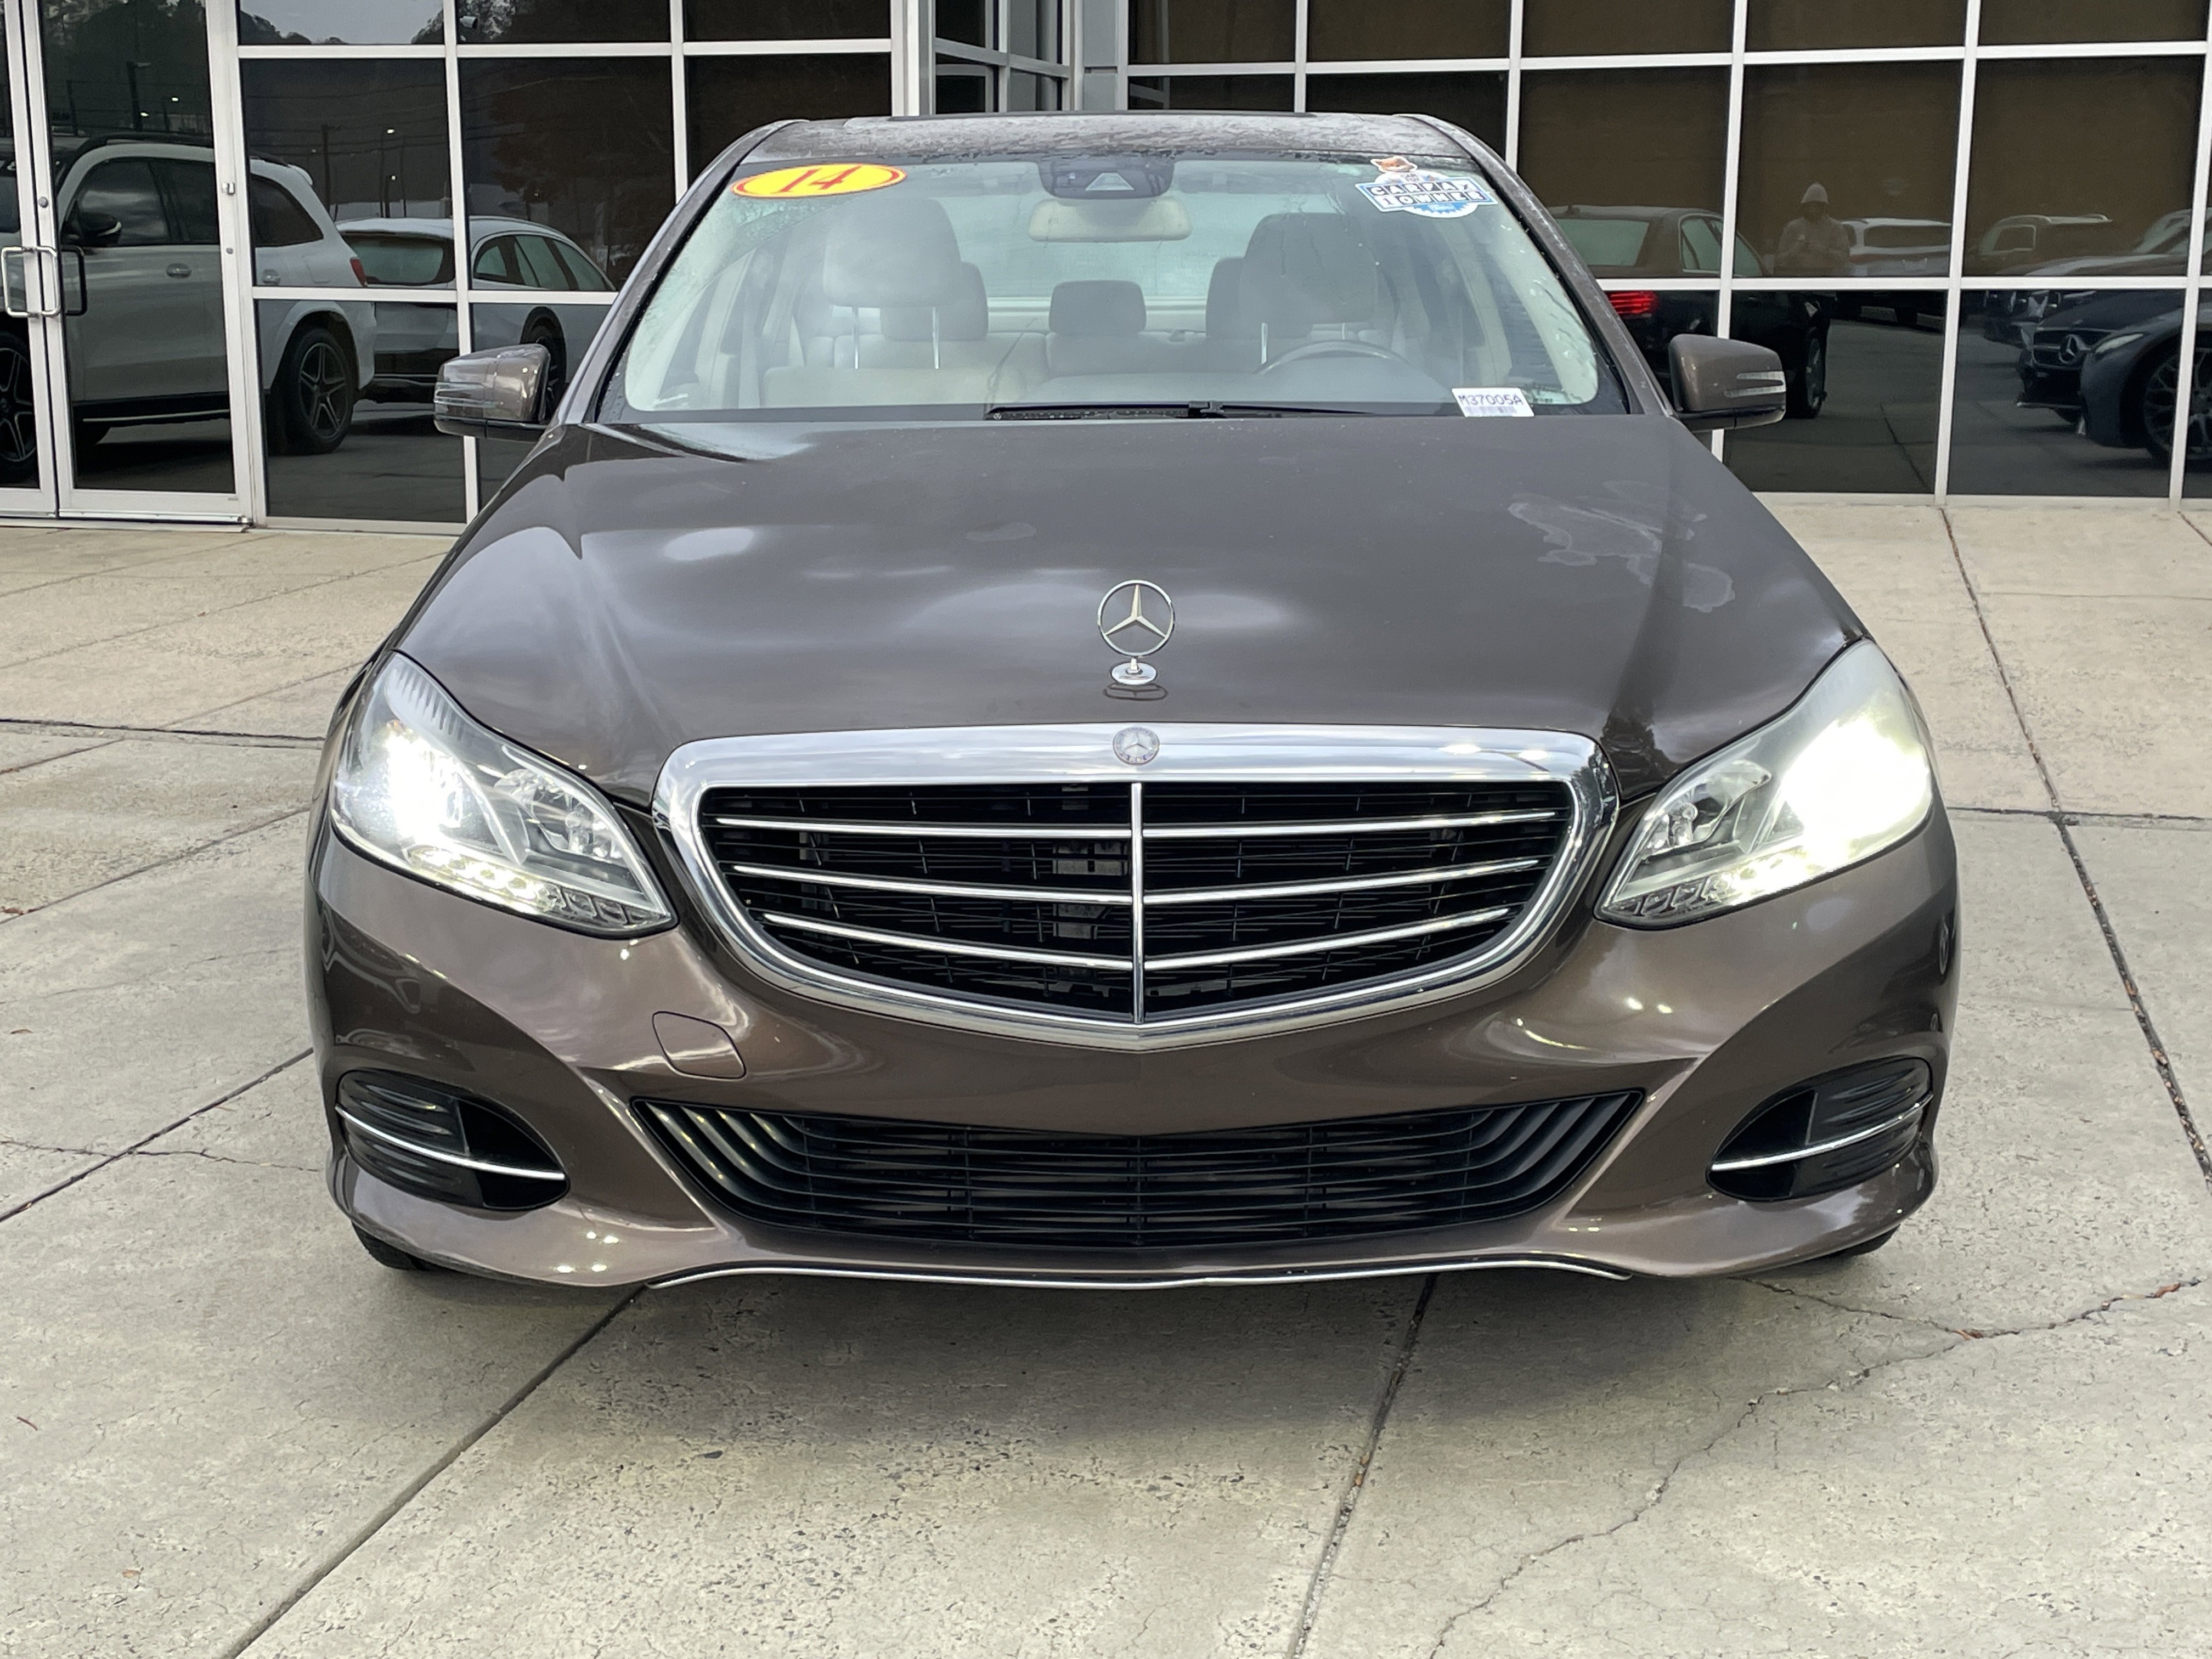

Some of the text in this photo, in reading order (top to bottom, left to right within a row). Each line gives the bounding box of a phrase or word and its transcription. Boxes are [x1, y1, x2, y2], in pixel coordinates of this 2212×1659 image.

[777, 165, 862, 193] 14
[1371, 182, 1476, 195] CARFAX
[1399, 192, 1485, 205] OWNER
[1458, 394, 1524, 405] M37005A
